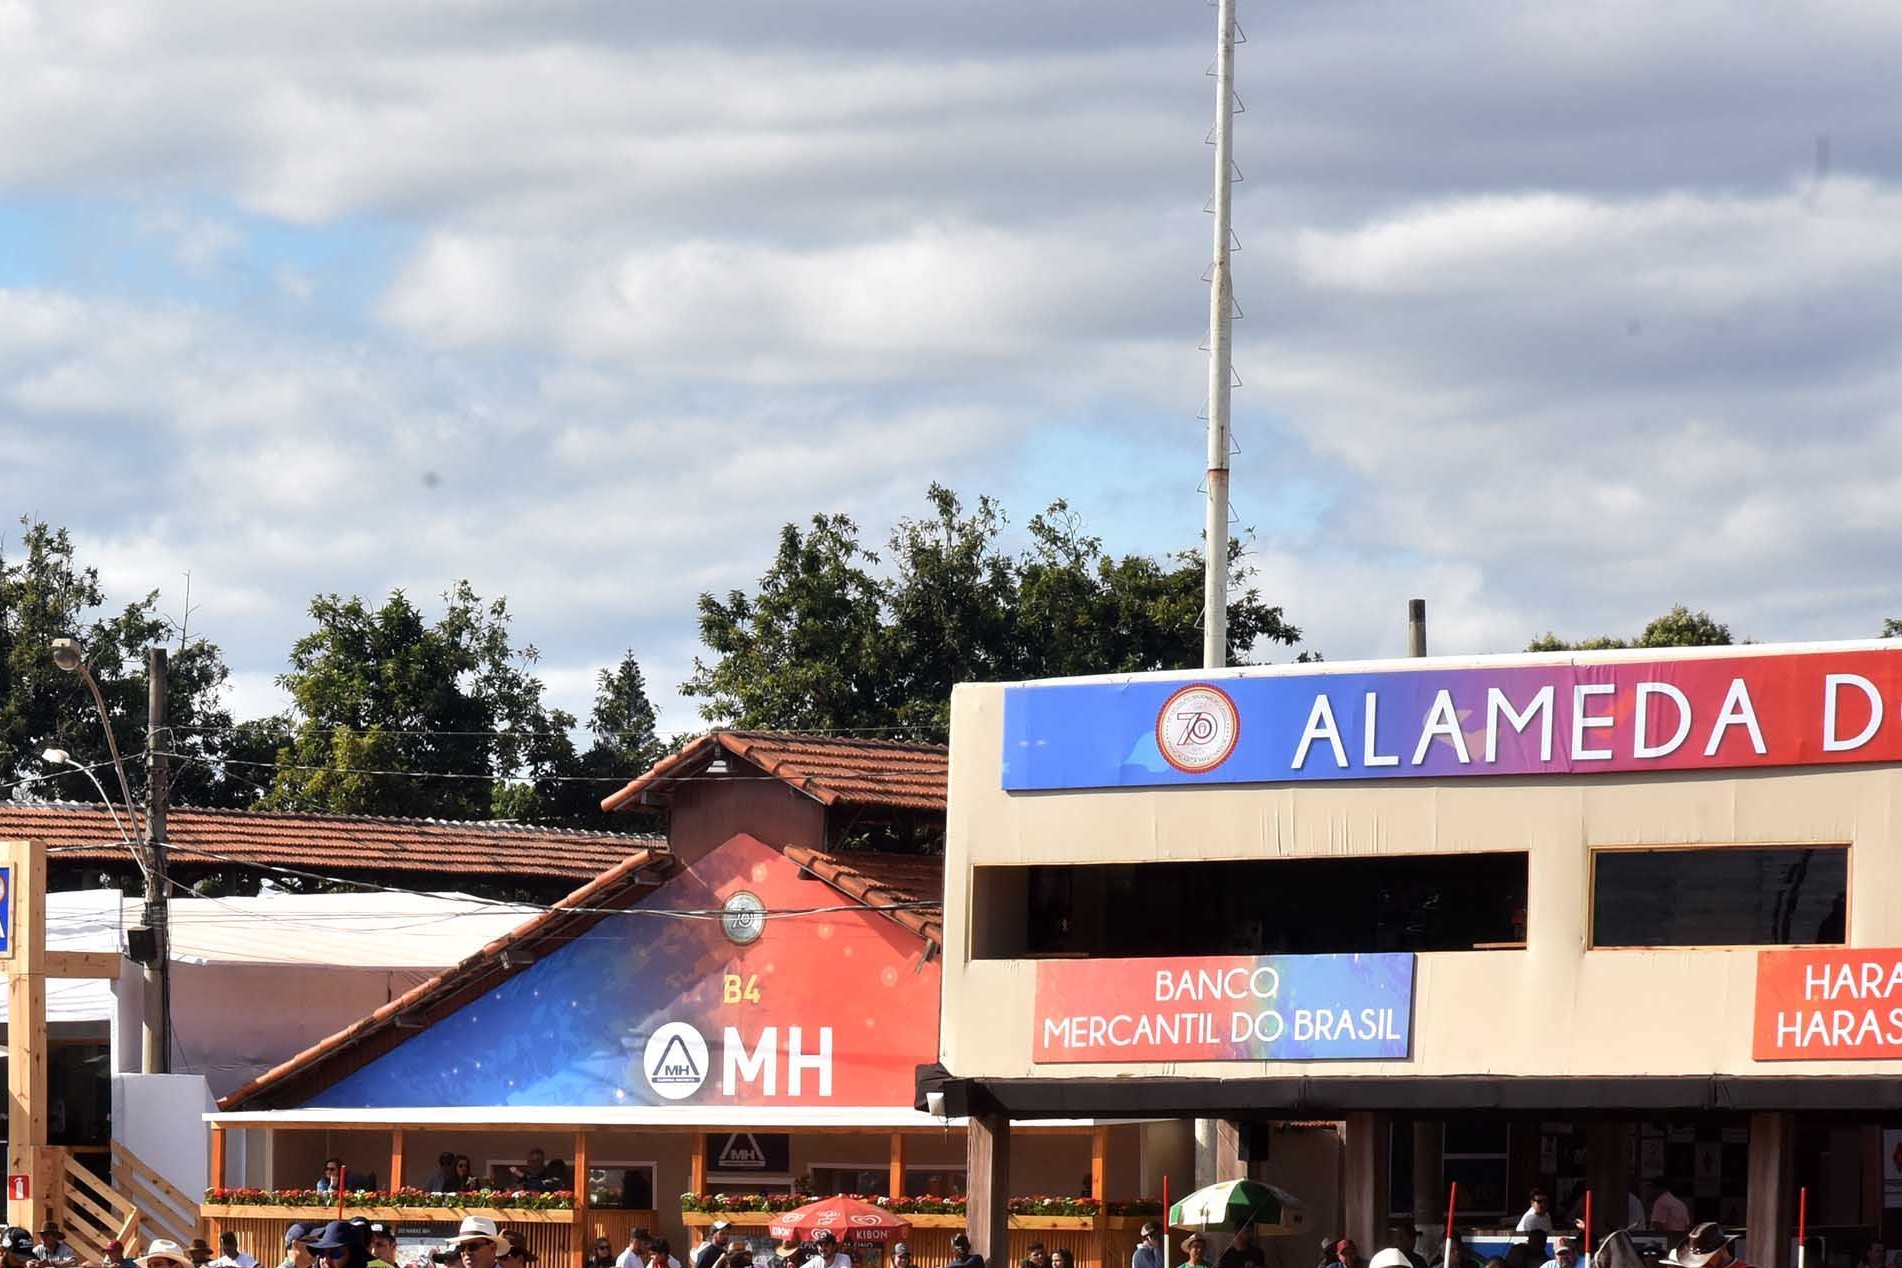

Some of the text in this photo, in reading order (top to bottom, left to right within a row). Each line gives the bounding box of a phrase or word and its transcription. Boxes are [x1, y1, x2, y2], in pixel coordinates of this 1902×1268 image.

[1291, 678, 1767, 769] ALAMEDA
[1823, 673, 1902, 752] D
[723, 974, 761, 1004] B4
[1155, 967, 1279, 1000] BANCO
[1044, 1008, 1400, 1048] MERCANTIL DO BRASIL
[1777, 1007, 1902, 1047] HARAS
[665, 1065, 689, 1075] MH
[723, 1026, 833, 1097] MH
[730, 1150, 755, 1160] MH
[856, 1230, 887, 1239] KIBON
